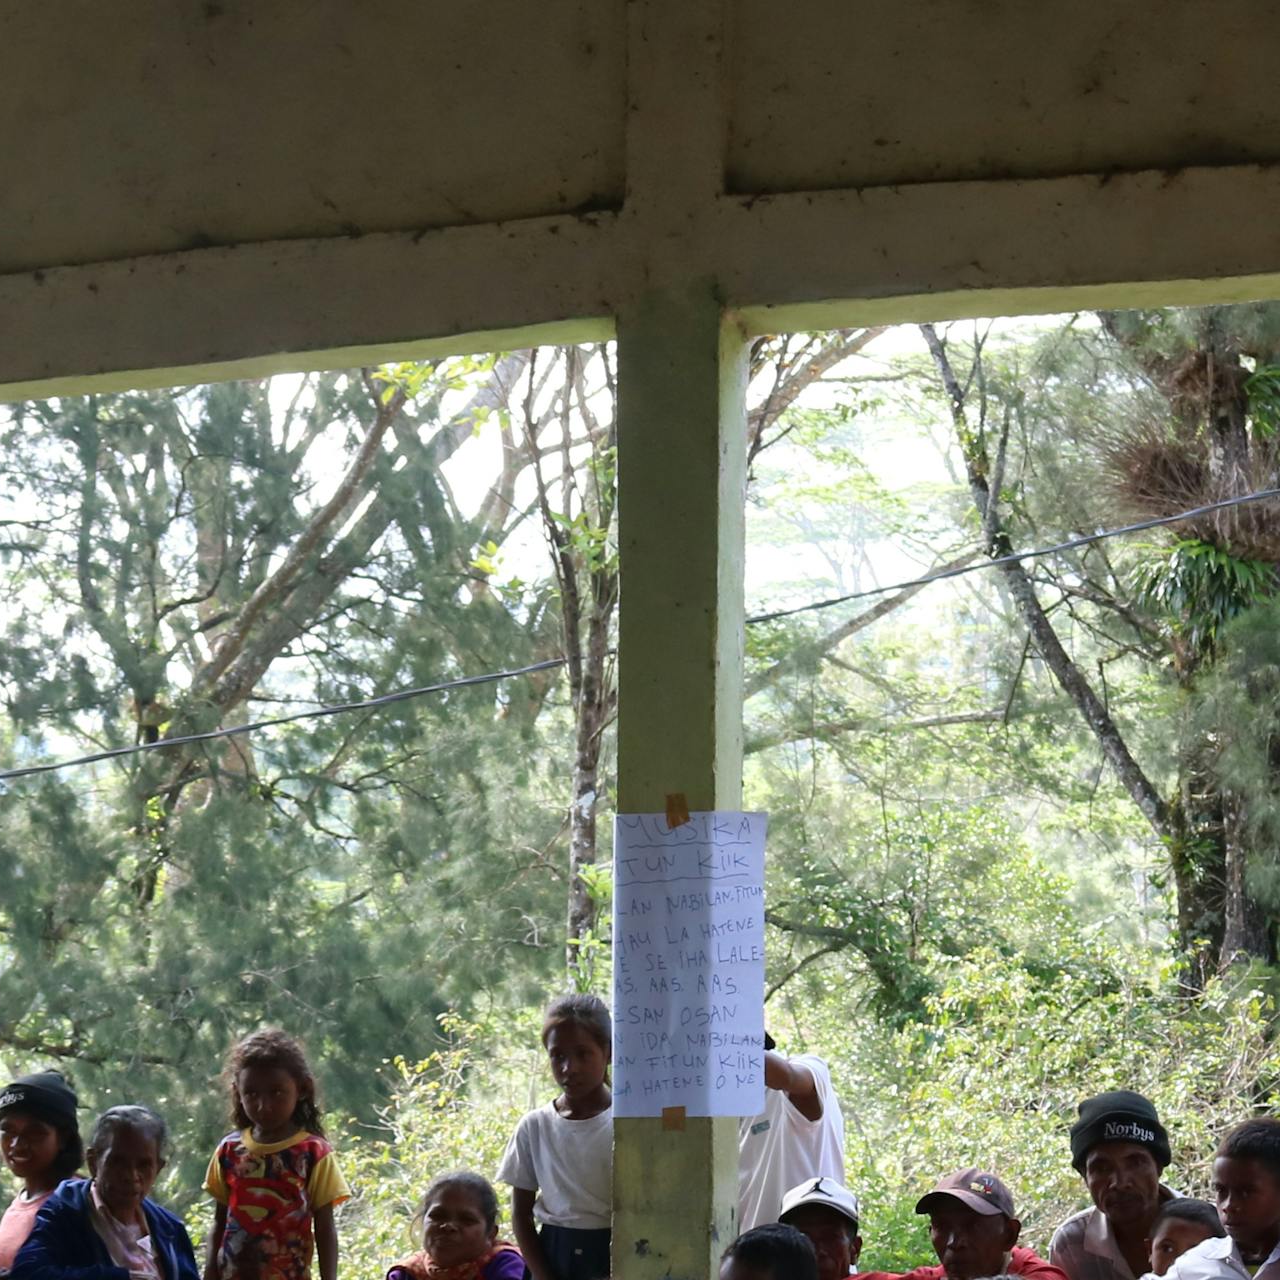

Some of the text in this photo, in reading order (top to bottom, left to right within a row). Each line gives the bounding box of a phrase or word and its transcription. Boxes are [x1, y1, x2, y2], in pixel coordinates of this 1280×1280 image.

[664, 925, 690, 945] LA
[699, 917, 754, 939] HATENE
[645, 953, 668, 971] SE
[679, 1004, 738, 1027] OSAN
[641, 1074, 705, 1097] HATENE
[1104, 1121, 1155, 1142] Norbys
